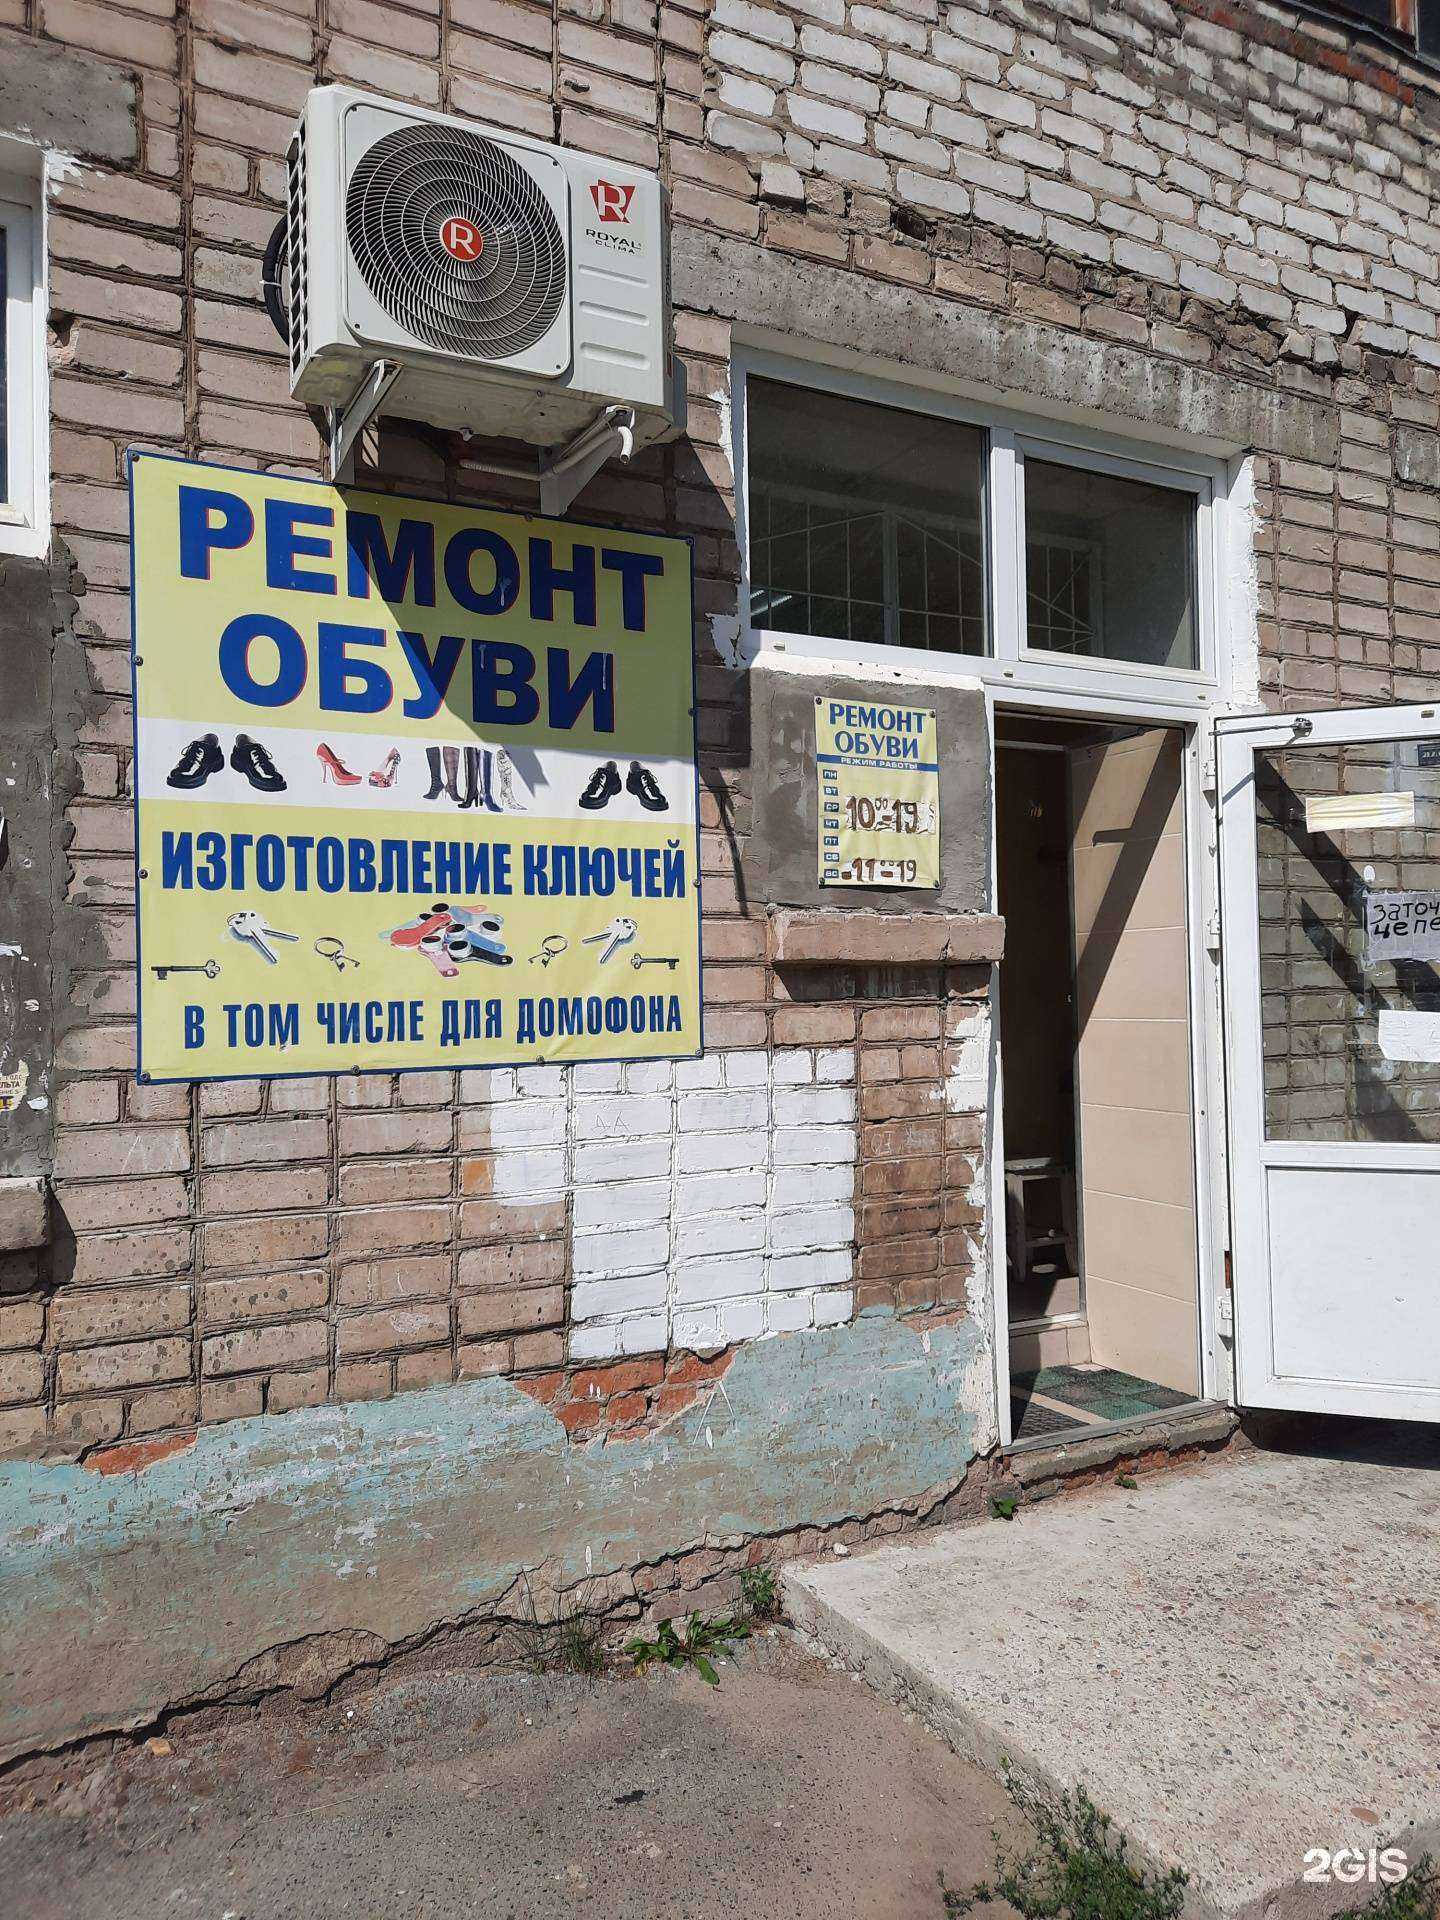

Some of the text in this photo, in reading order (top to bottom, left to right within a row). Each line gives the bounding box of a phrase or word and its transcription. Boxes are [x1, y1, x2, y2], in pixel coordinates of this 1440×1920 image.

[450, 221, 476, 256] R
[585, 228, 641, 250] ROYAL
[595, 239, 636, 255] CLIMA
[178, 484, 665, 633] РЕМОНТ
[218, 613, 616, 734] ОБУВИ
[829, 703, 926, 733] РЕМОНТ
[834, 730, 918, 759] ОБУВИ
[823, 770, 837, 778] ПН
[841, 757, 918, 770] РЕЖИМ РАБОТЫ
[825, 787, 837, 795] ВТ
[825, 803, 838, 811] СР
[825, 820, 838, 828] ЧТ
[825, 837, 838, 845] ПТ
[161, 831, 686, 898] ИЗГОТОВЛЕНИЕ КЛЮЧЕЙ
[184, 994, 683, 1050] В ТОМ ЧИСЛЕ ДЛЯ ДОМОФОНА
